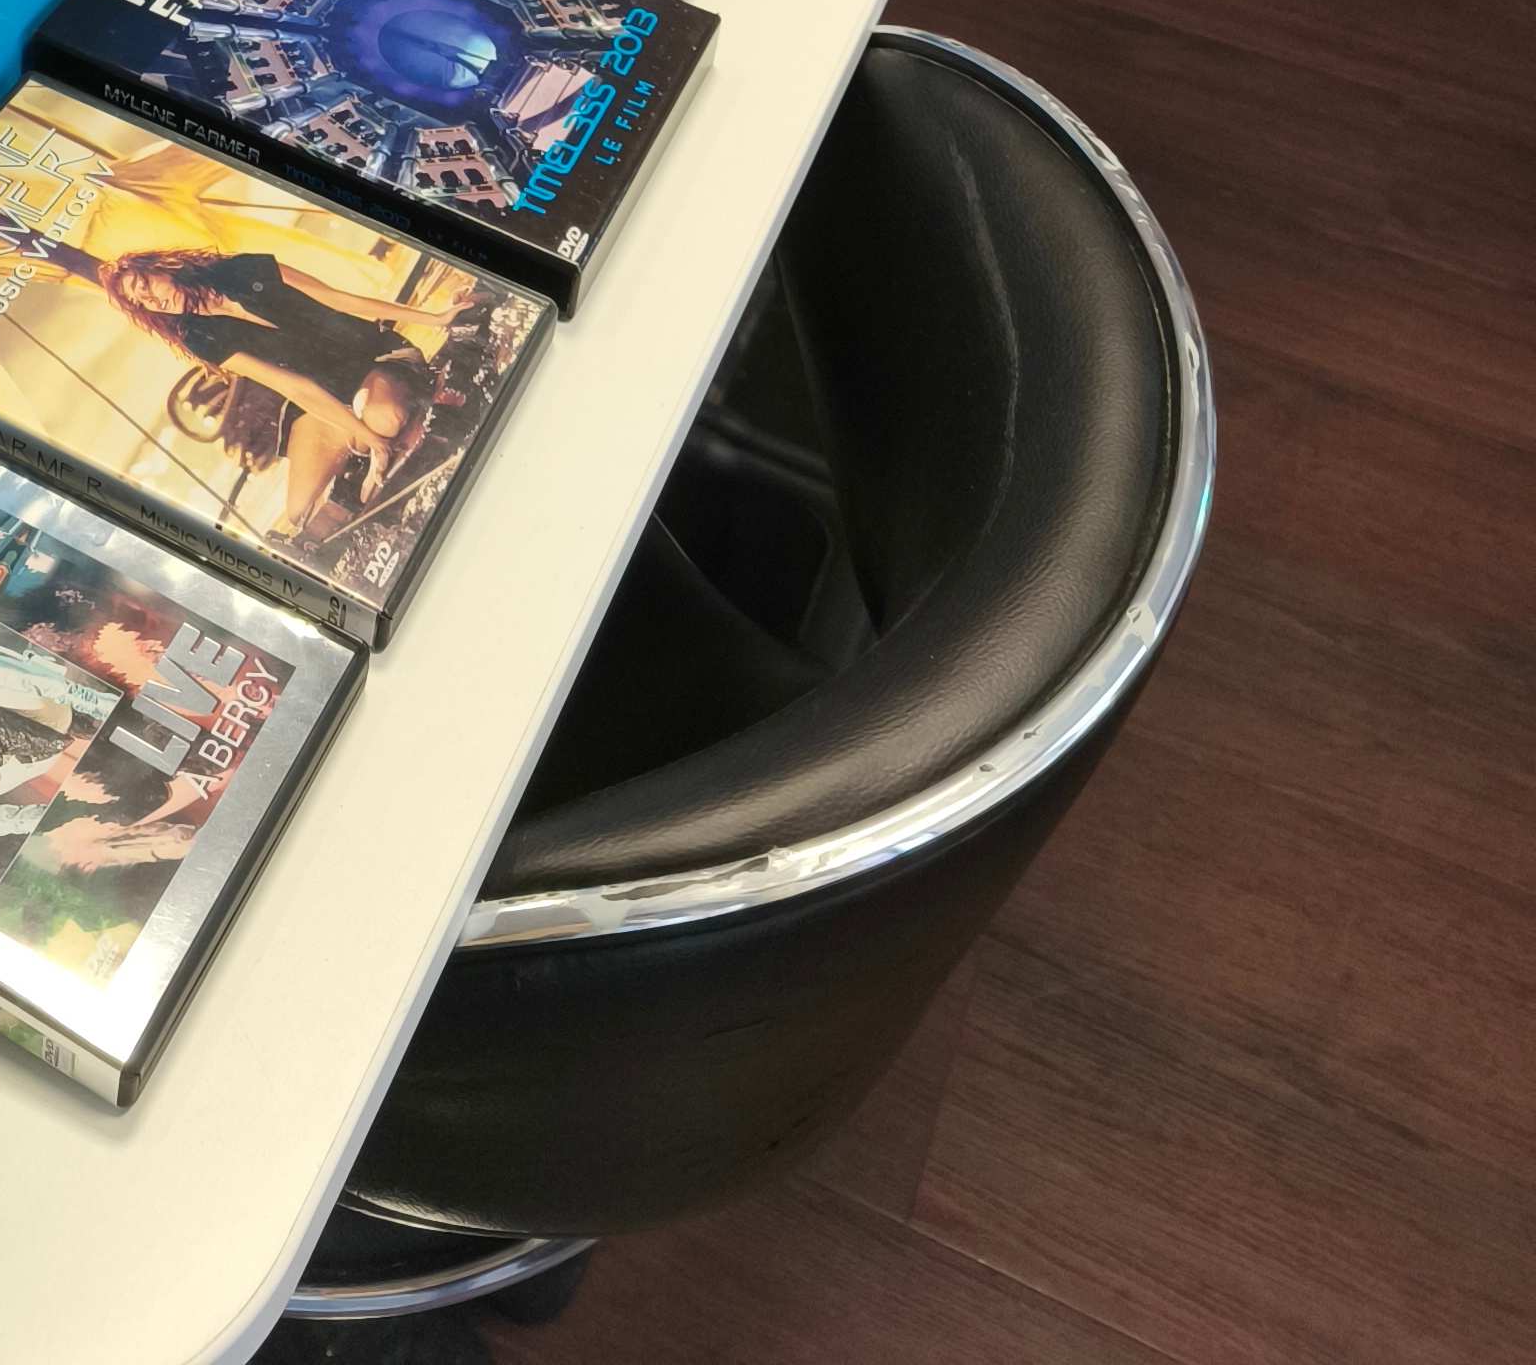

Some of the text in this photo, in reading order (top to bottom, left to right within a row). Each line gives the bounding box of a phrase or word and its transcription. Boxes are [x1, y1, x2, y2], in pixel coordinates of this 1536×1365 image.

[601, 6, 660, 83] 2013
[104, 83, 178, 129] MYLENE
[184, 118, 262, 166] FARMER
[594, 79, 657, 167] LE FILM
[28, 174, 98, 263] VIDEOS
[82, 158, 115, 199] IV
[556, 225, 583, 259] DVD
[139, 502, 201, 548] MUSIC
[206, 537, 276, 591] VIDEOS
[280, 576, 304, 601] IV
[363, 539, 392, 577] DVD
[108, 621, 246, 779] LIVE
[199, 660, 273, 776] BERCY
